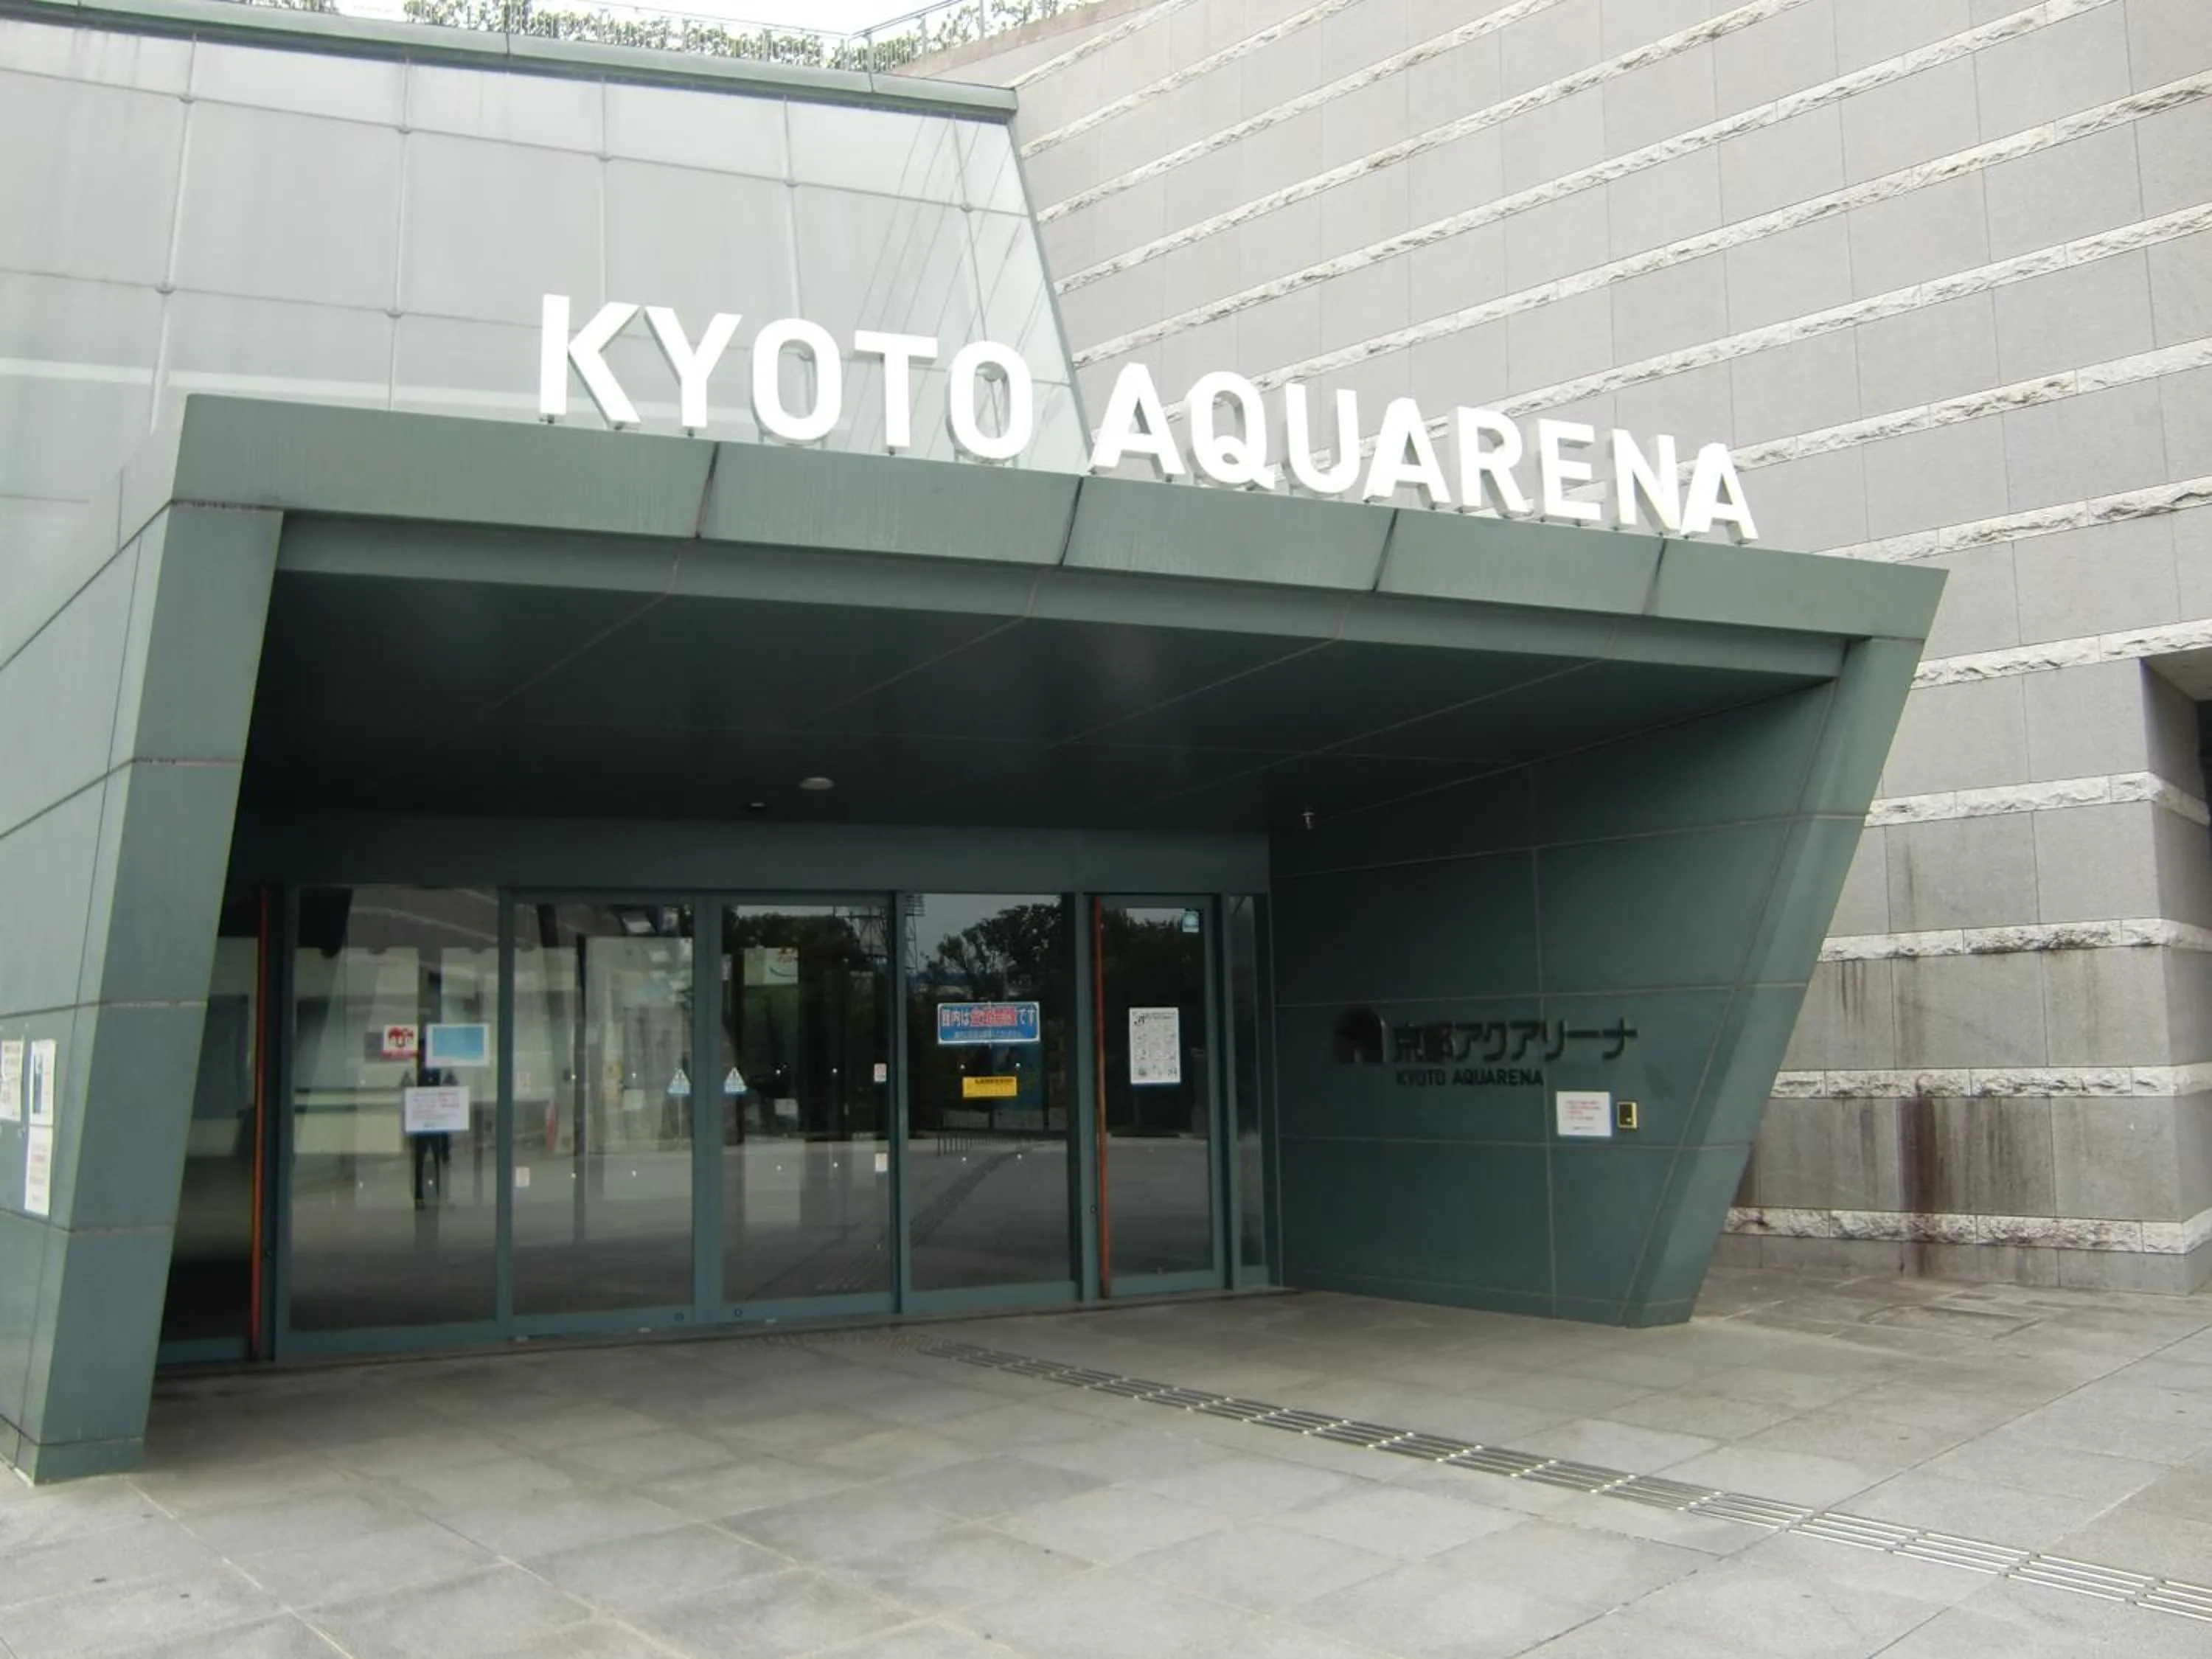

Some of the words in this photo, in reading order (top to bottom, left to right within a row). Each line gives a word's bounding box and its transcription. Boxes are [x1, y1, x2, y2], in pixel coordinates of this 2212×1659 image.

[539, 293, 1034, 462] KYOTO
[1087, 361, 1759, 544] AQUARENA
[1395, 1068, 1447, 1087] KYOTO
[1452, 1068, 1545, 1087] AQUARENA
